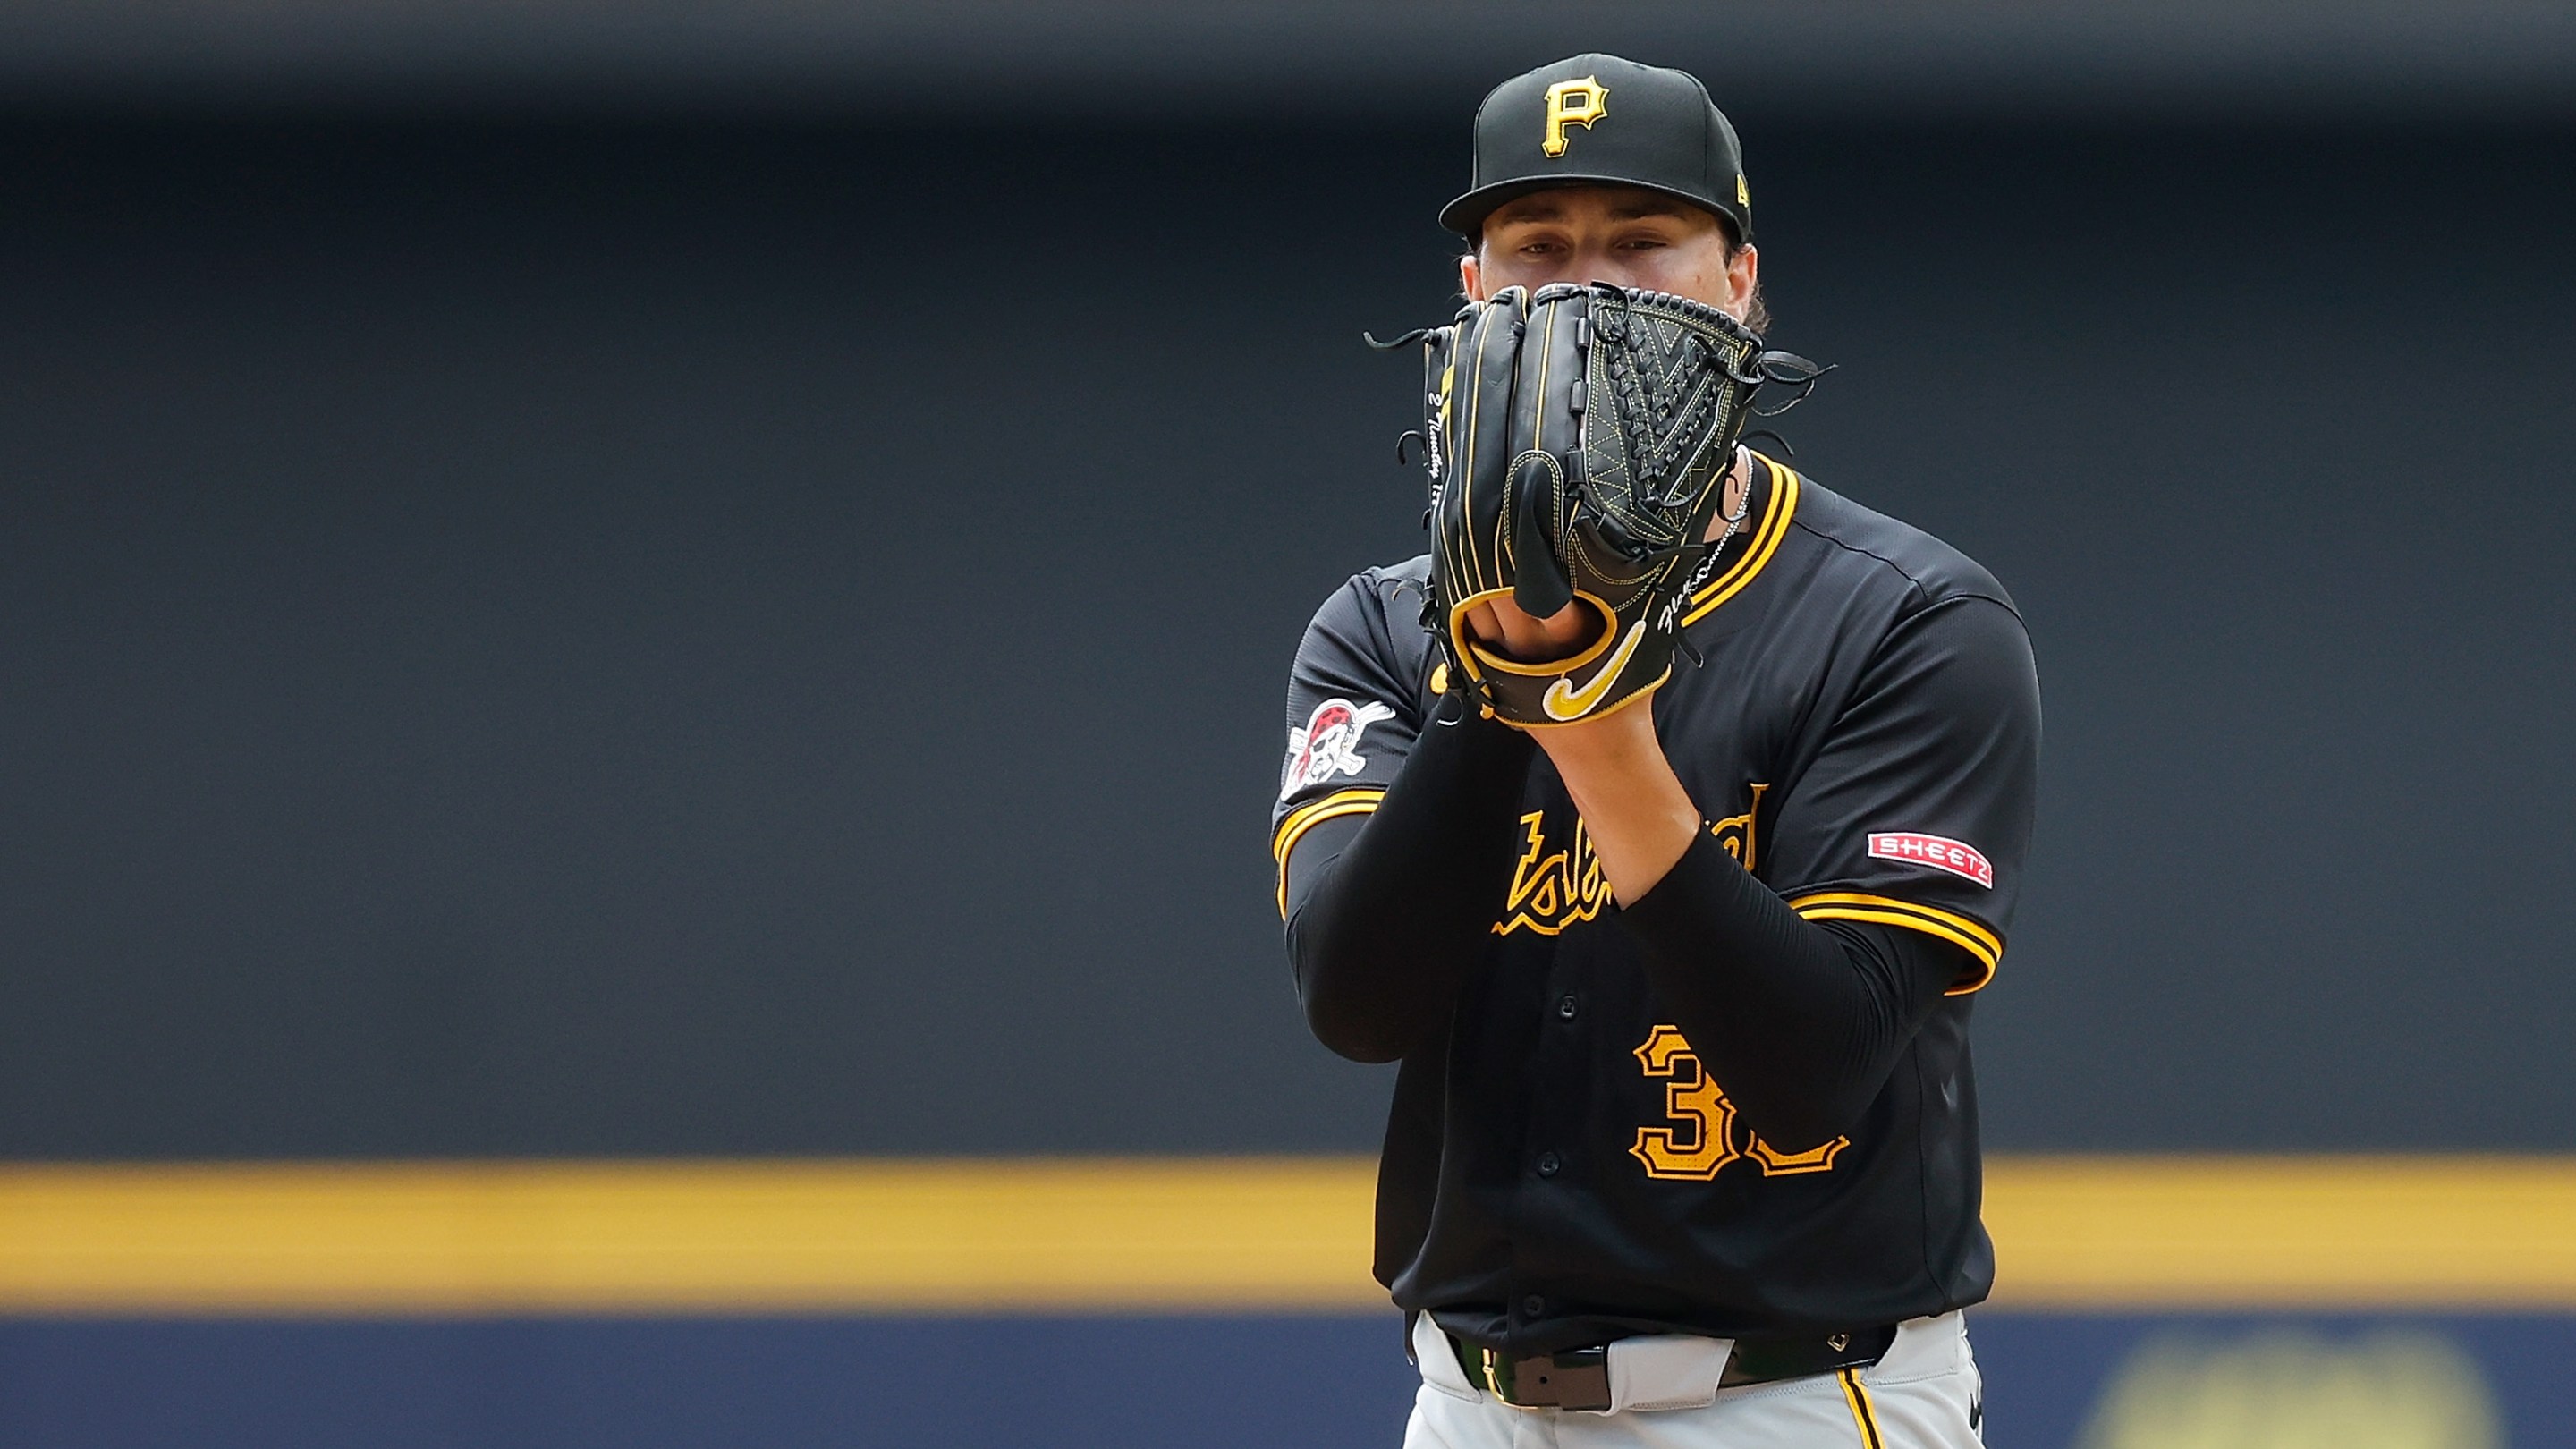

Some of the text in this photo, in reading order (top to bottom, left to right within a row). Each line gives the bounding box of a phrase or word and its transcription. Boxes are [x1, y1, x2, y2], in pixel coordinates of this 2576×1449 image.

[1541, 74, 1610, 158] P
[1428, 392, 1443, 407] 2
[1427, 411, 1444, 479] Timothy
[1879, 837, 1989, 880] SHEETZ
